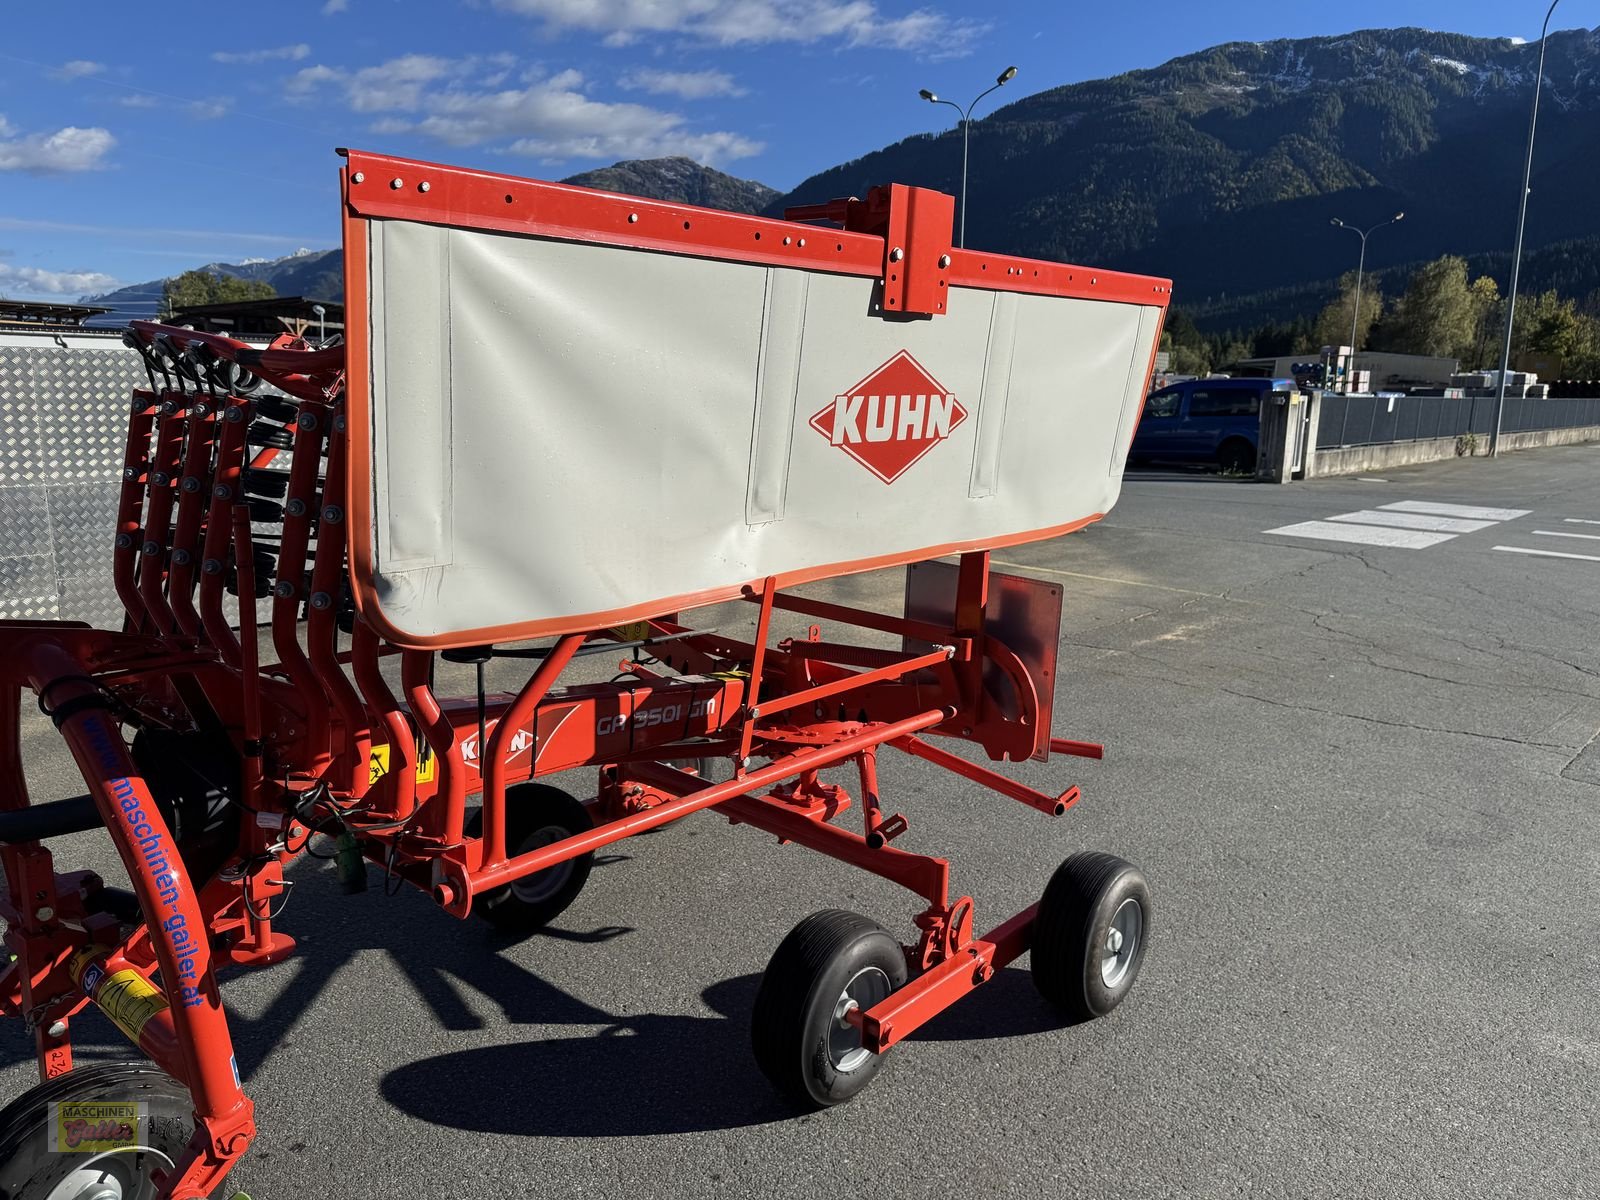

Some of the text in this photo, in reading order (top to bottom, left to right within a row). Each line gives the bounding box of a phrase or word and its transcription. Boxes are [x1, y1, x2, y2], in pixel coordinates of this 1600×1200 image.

[831, 393, 956, 446] KUHN
[596, 713, 627, 736] GA
[688, 697, 716, 719] GM
[461, 732, 526, 761] KN
[82, 715, 205, 1009] www.maschinen-gailer.at
